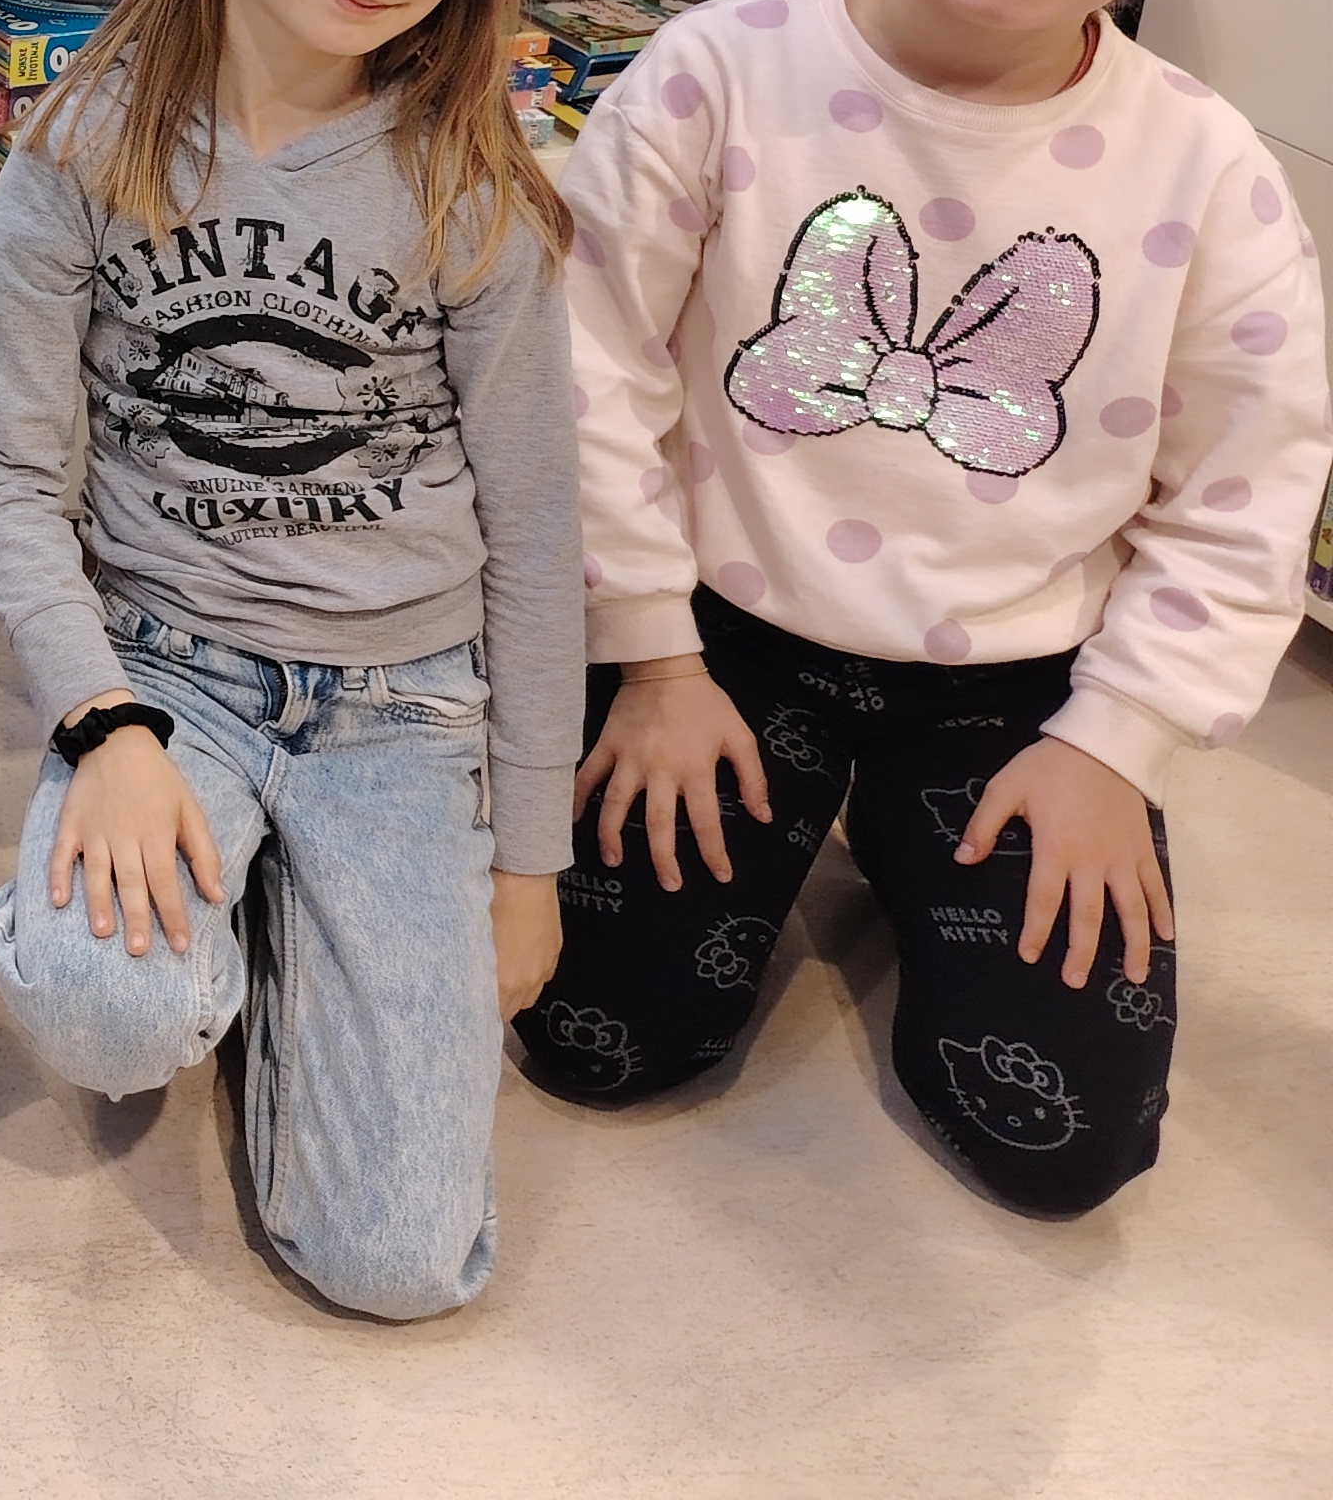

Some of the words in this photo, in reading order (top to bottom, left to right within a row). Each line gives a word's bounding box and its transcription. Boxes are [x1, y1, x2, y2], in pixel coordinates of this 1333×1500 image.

[140, 290, 252, 326] FASHION
[930, 907, 1001, 925] HELLO
[939, 925, 1011, 945] KITTY
